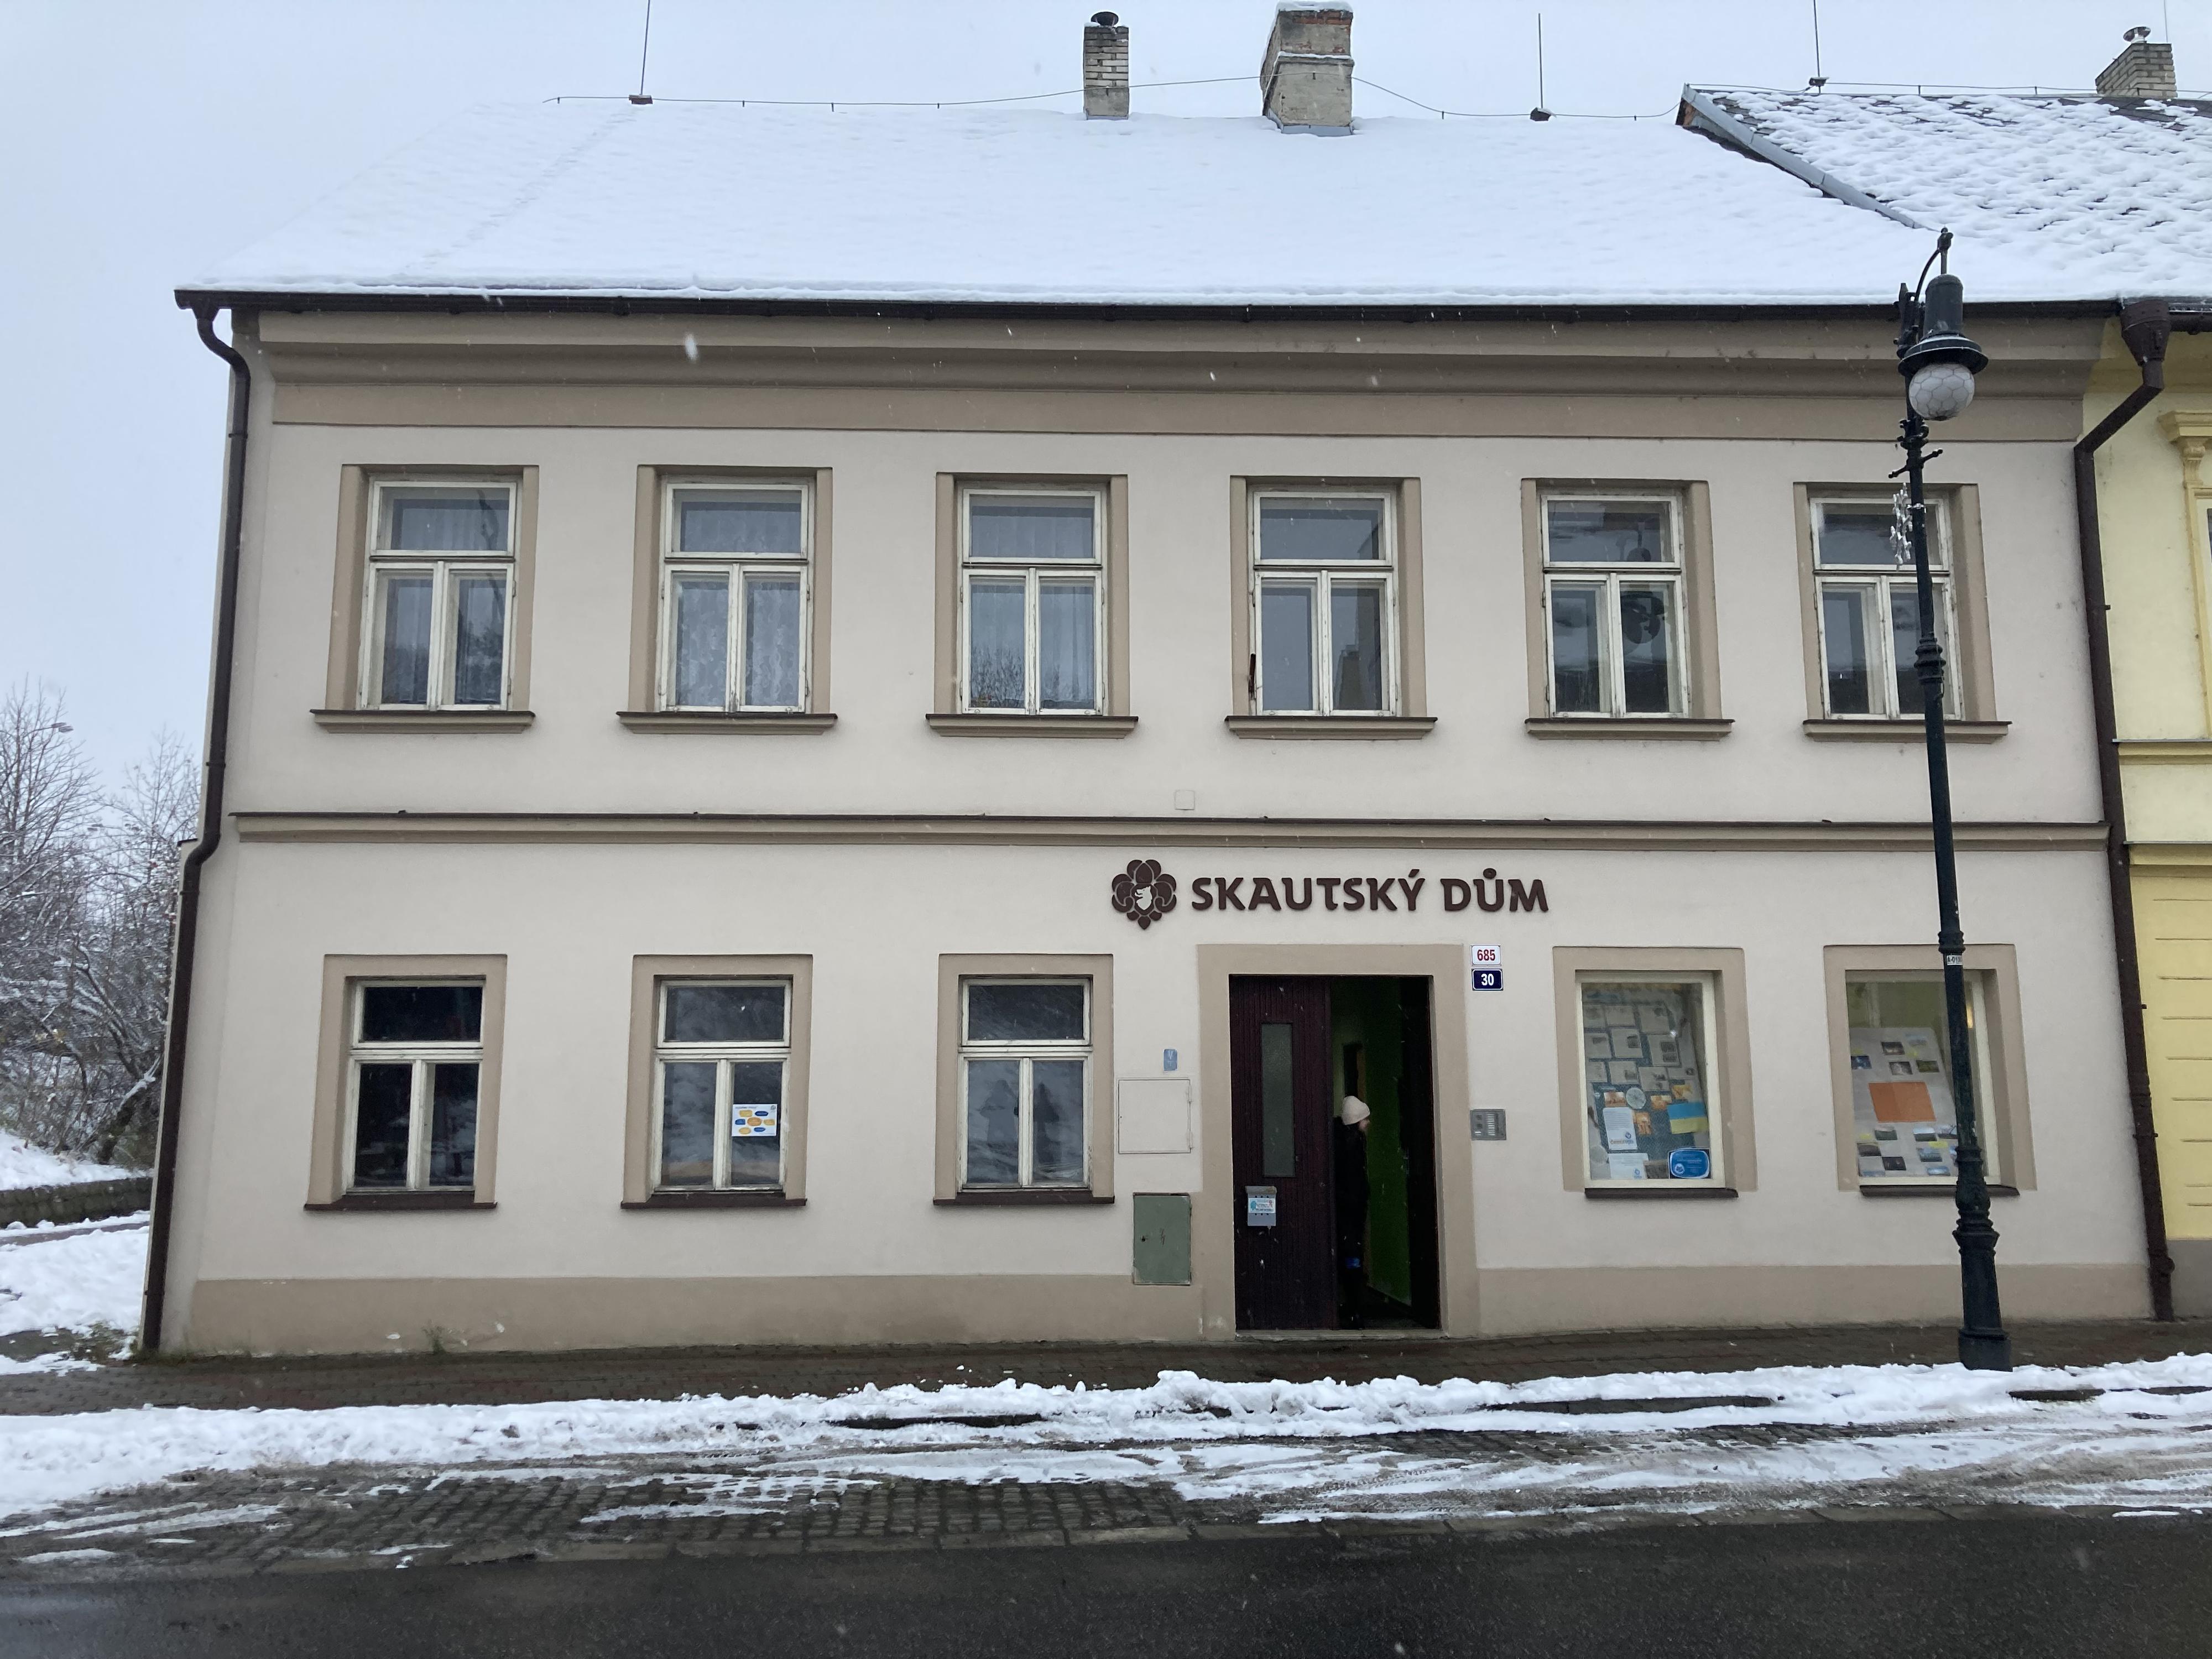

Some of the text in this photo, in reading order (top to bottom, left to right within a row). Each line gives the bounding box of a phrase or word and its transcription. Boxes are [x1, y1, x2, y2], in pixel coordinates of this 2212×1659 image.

[1192, 868, 1549, 912] SKAUTSKÝ DŮM
[1477, 949, 1495, 961] 685
[1481, 973, 1494, 986] 30
